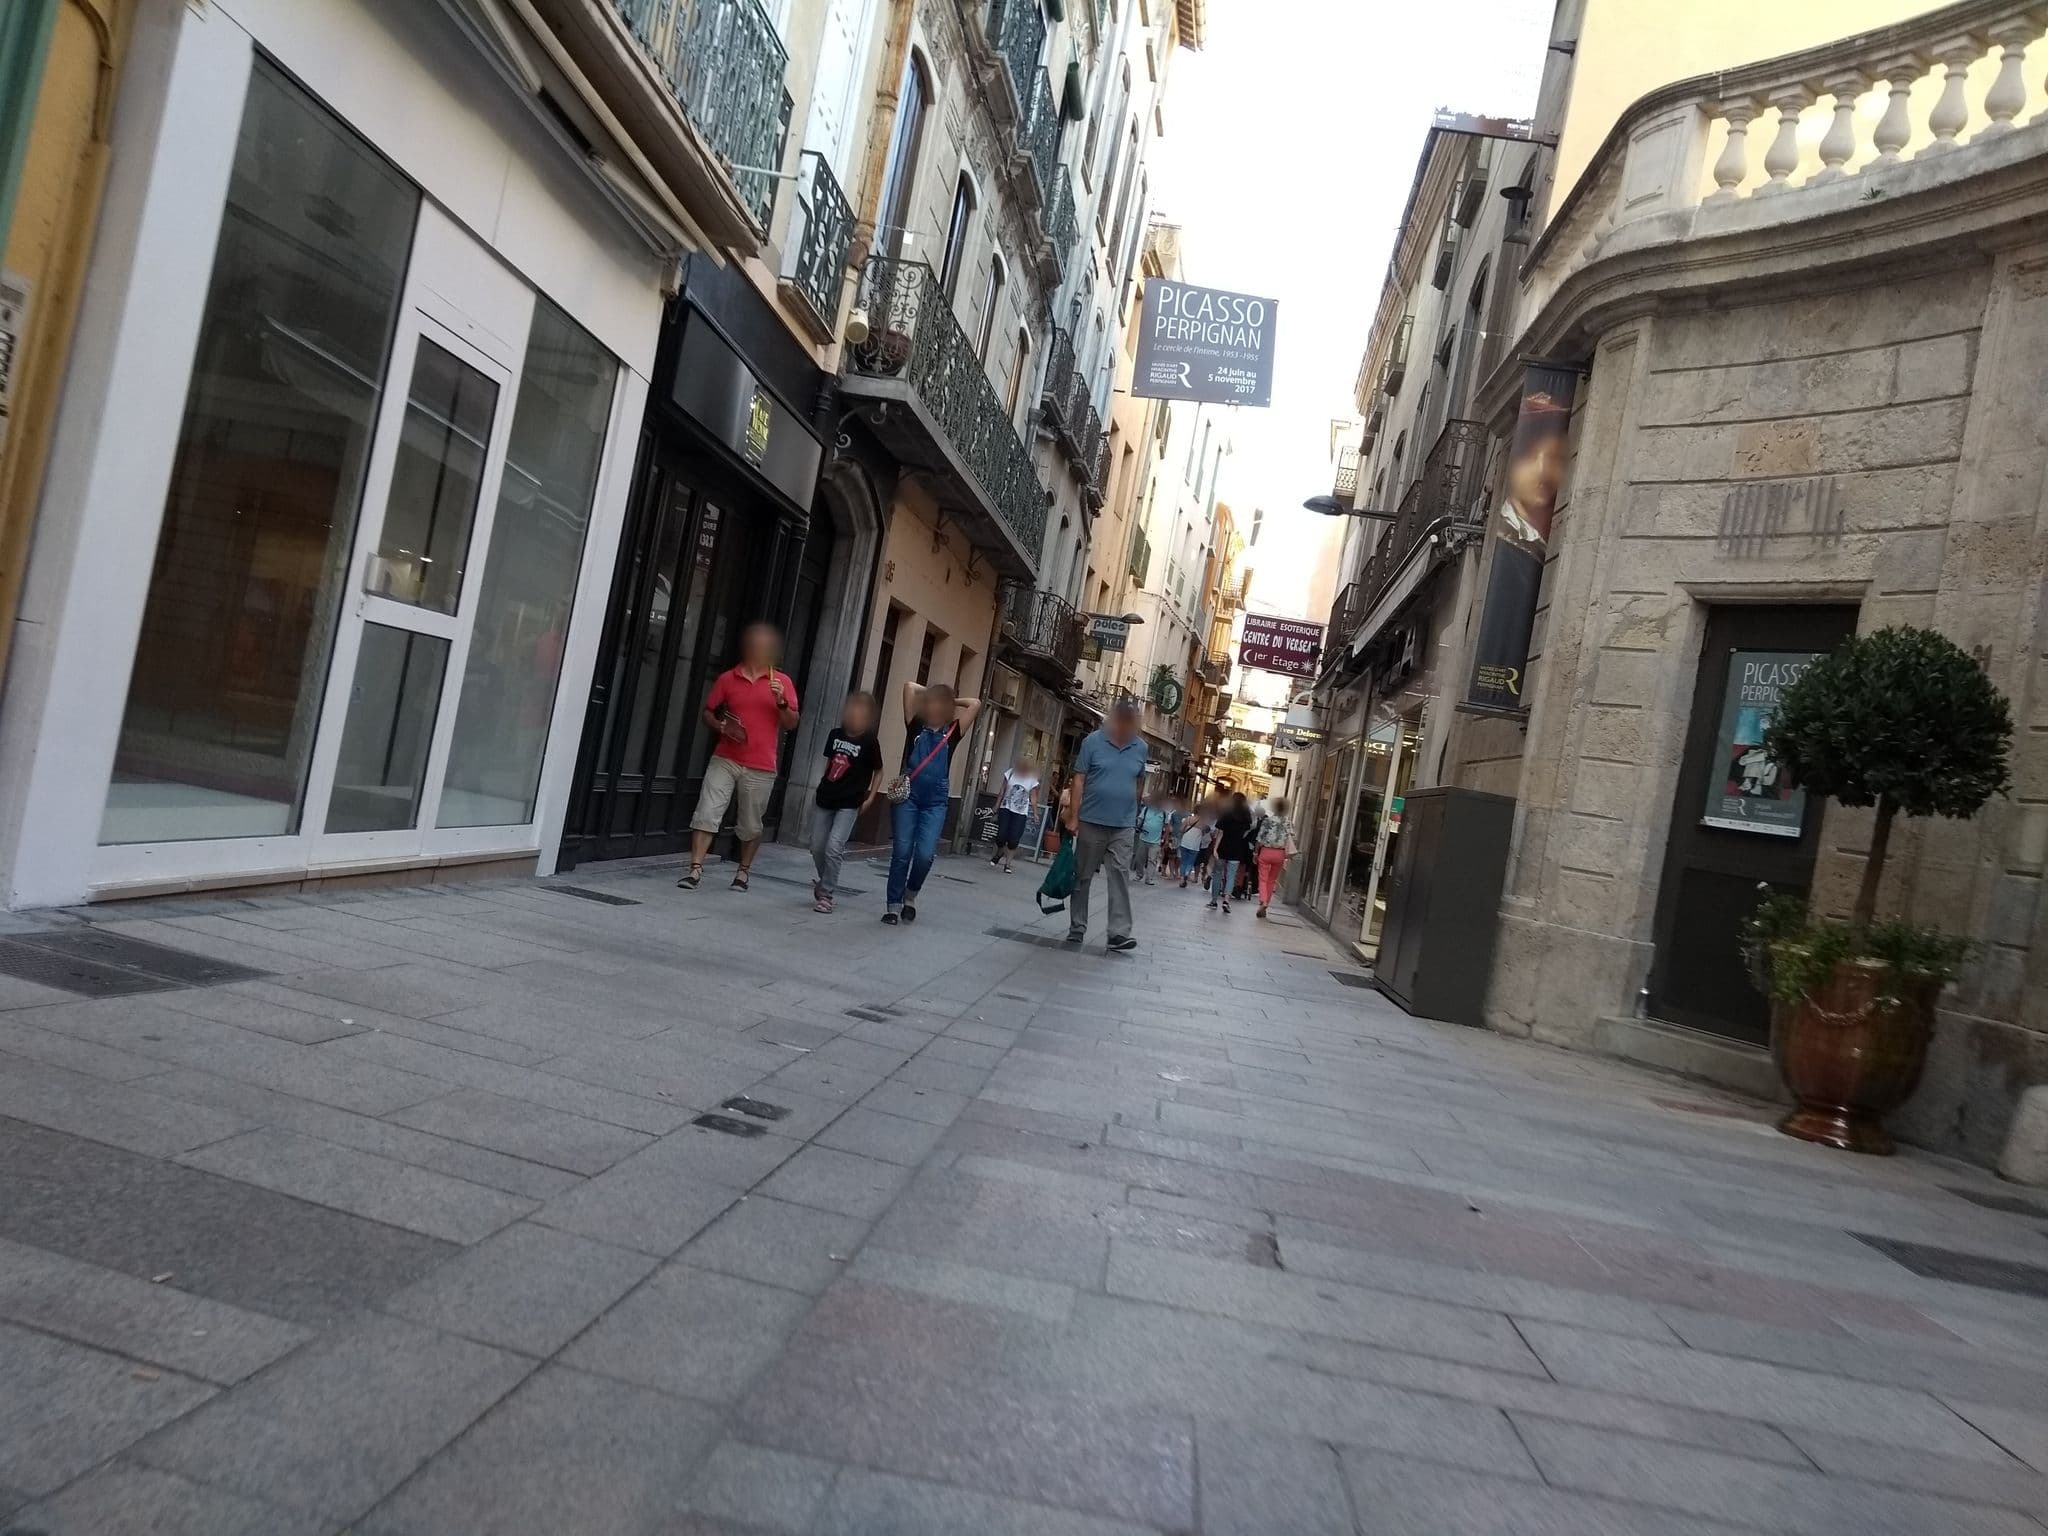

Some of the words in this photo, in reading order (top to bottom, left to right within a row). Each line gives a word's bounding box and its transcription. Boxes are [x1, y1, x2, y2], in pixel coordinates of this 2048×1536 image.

[1157, 286, 1265, 328] PICASSO
[1155, 316, 1262, 350] PERPIGNAN
[1153, 343, 1162, 351] Le
[1163, 344, 1182, 353] cercle
[1184, 345, 1192, 353] de
[1222, 350, 1239, 359] 1953
[1150, 372, 1177, 380] RIGAUD
[1217, 366, 1228, 375] 24
[1228, 367, 1245, 377] juin
[1246, 370, 1257, 378] au
[1208, 374, 1214, 382] 5
[1214, 375, 1256, 386] novembre
[1234, 385, 1256, 394] 2017
[1246, 617, 1278, 629] LIBRAIRIE
[1280, 623, 1321, 637] ESOTERIQUE
[1243, 630, 1270, 646] CENTRE
[1272, 635, 1283, 648] DU
[1286, 637, 1318, 654] VERSEA
[1272, 655, 1300, 670] Etage
[1478, 676, 1504, 684] RIGAUD
[832, 738, 861, 758] STONES
